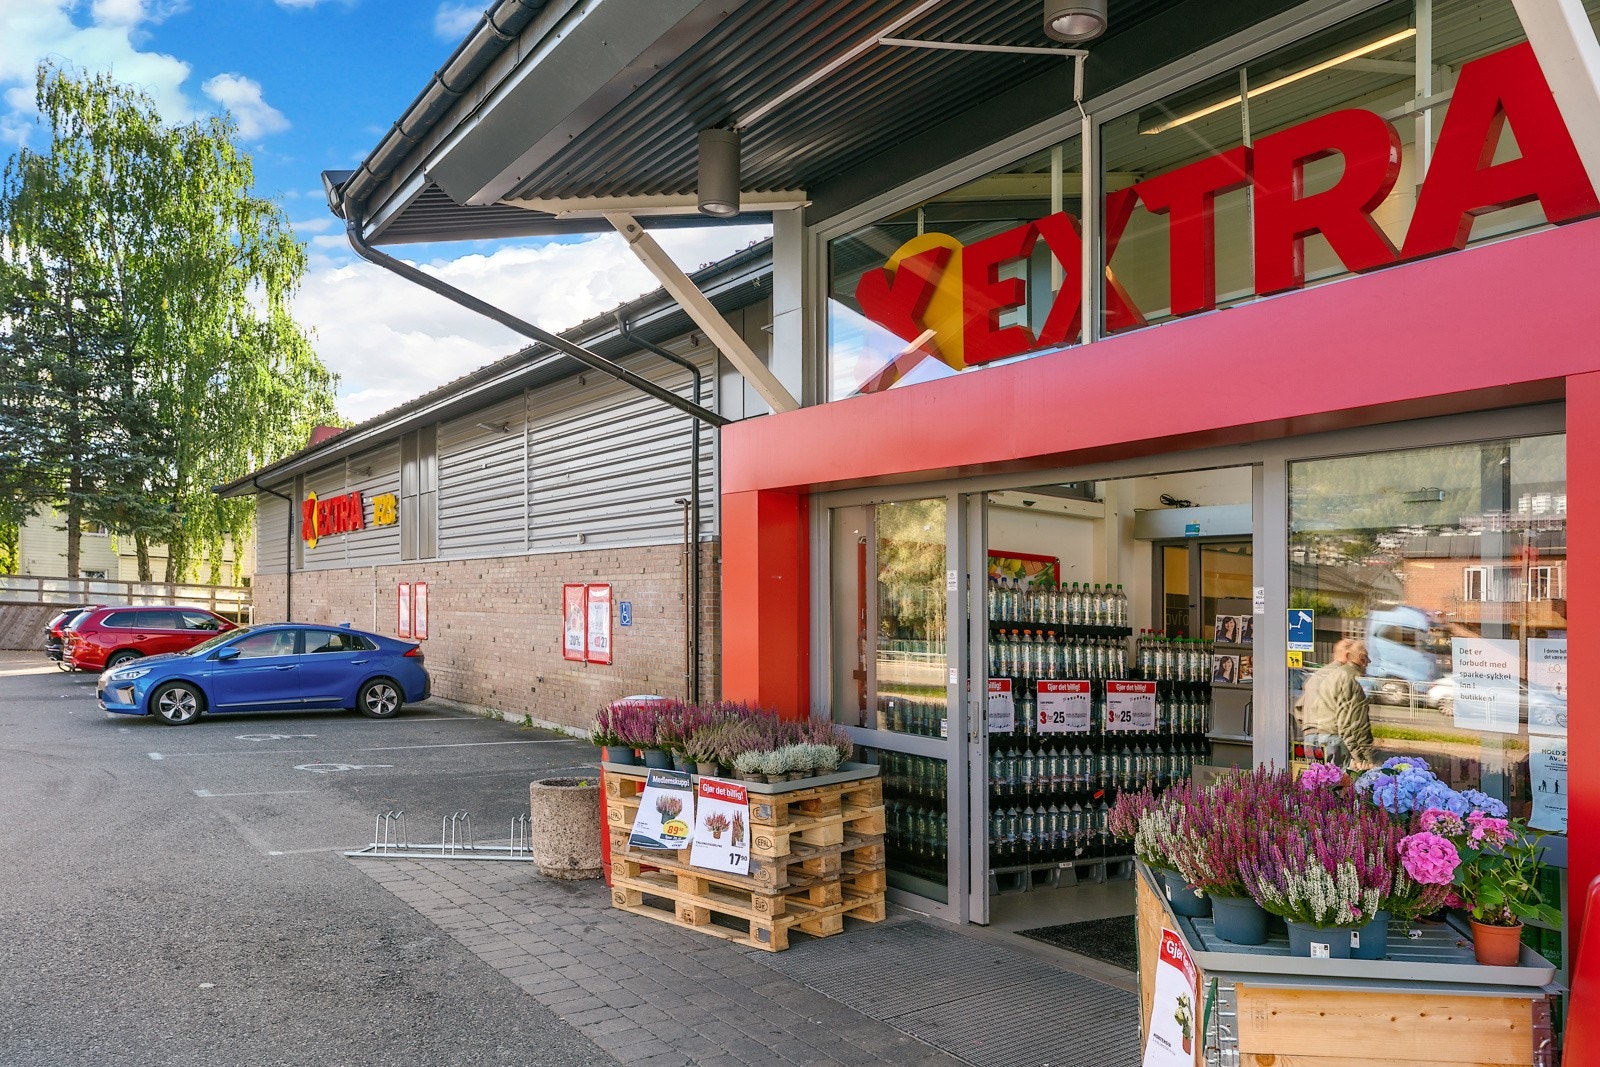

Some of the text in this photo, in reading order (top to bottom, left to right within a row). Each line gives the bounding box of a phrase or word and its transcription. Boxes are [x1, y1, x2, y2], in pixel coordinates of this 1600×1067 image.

[961, 41, 1600, 366] EXTRA
[317, 491, 365, 537] EXTRA
[1459, 647, 1472, 655] Det
[1459, 659, 1507, 669] forbudt med
[1047, 683, 1081, 692] Gjør det billig!
[1115, 683, 1126, 692] Gjør
[1134, 683, 1147, 693] billig!
[1039, 711, 1047, 724] 3
[1053, 711, 1065, 724] 25
[1108, 710, 1115, 723] 3
[1120, 710, 1132, 723] 25
[1541, 748, 1561, 756] HOLD
[652, 775, 690, 788] Medlemskupp!
[702, 783, 744, 801] Gjør det billig!
